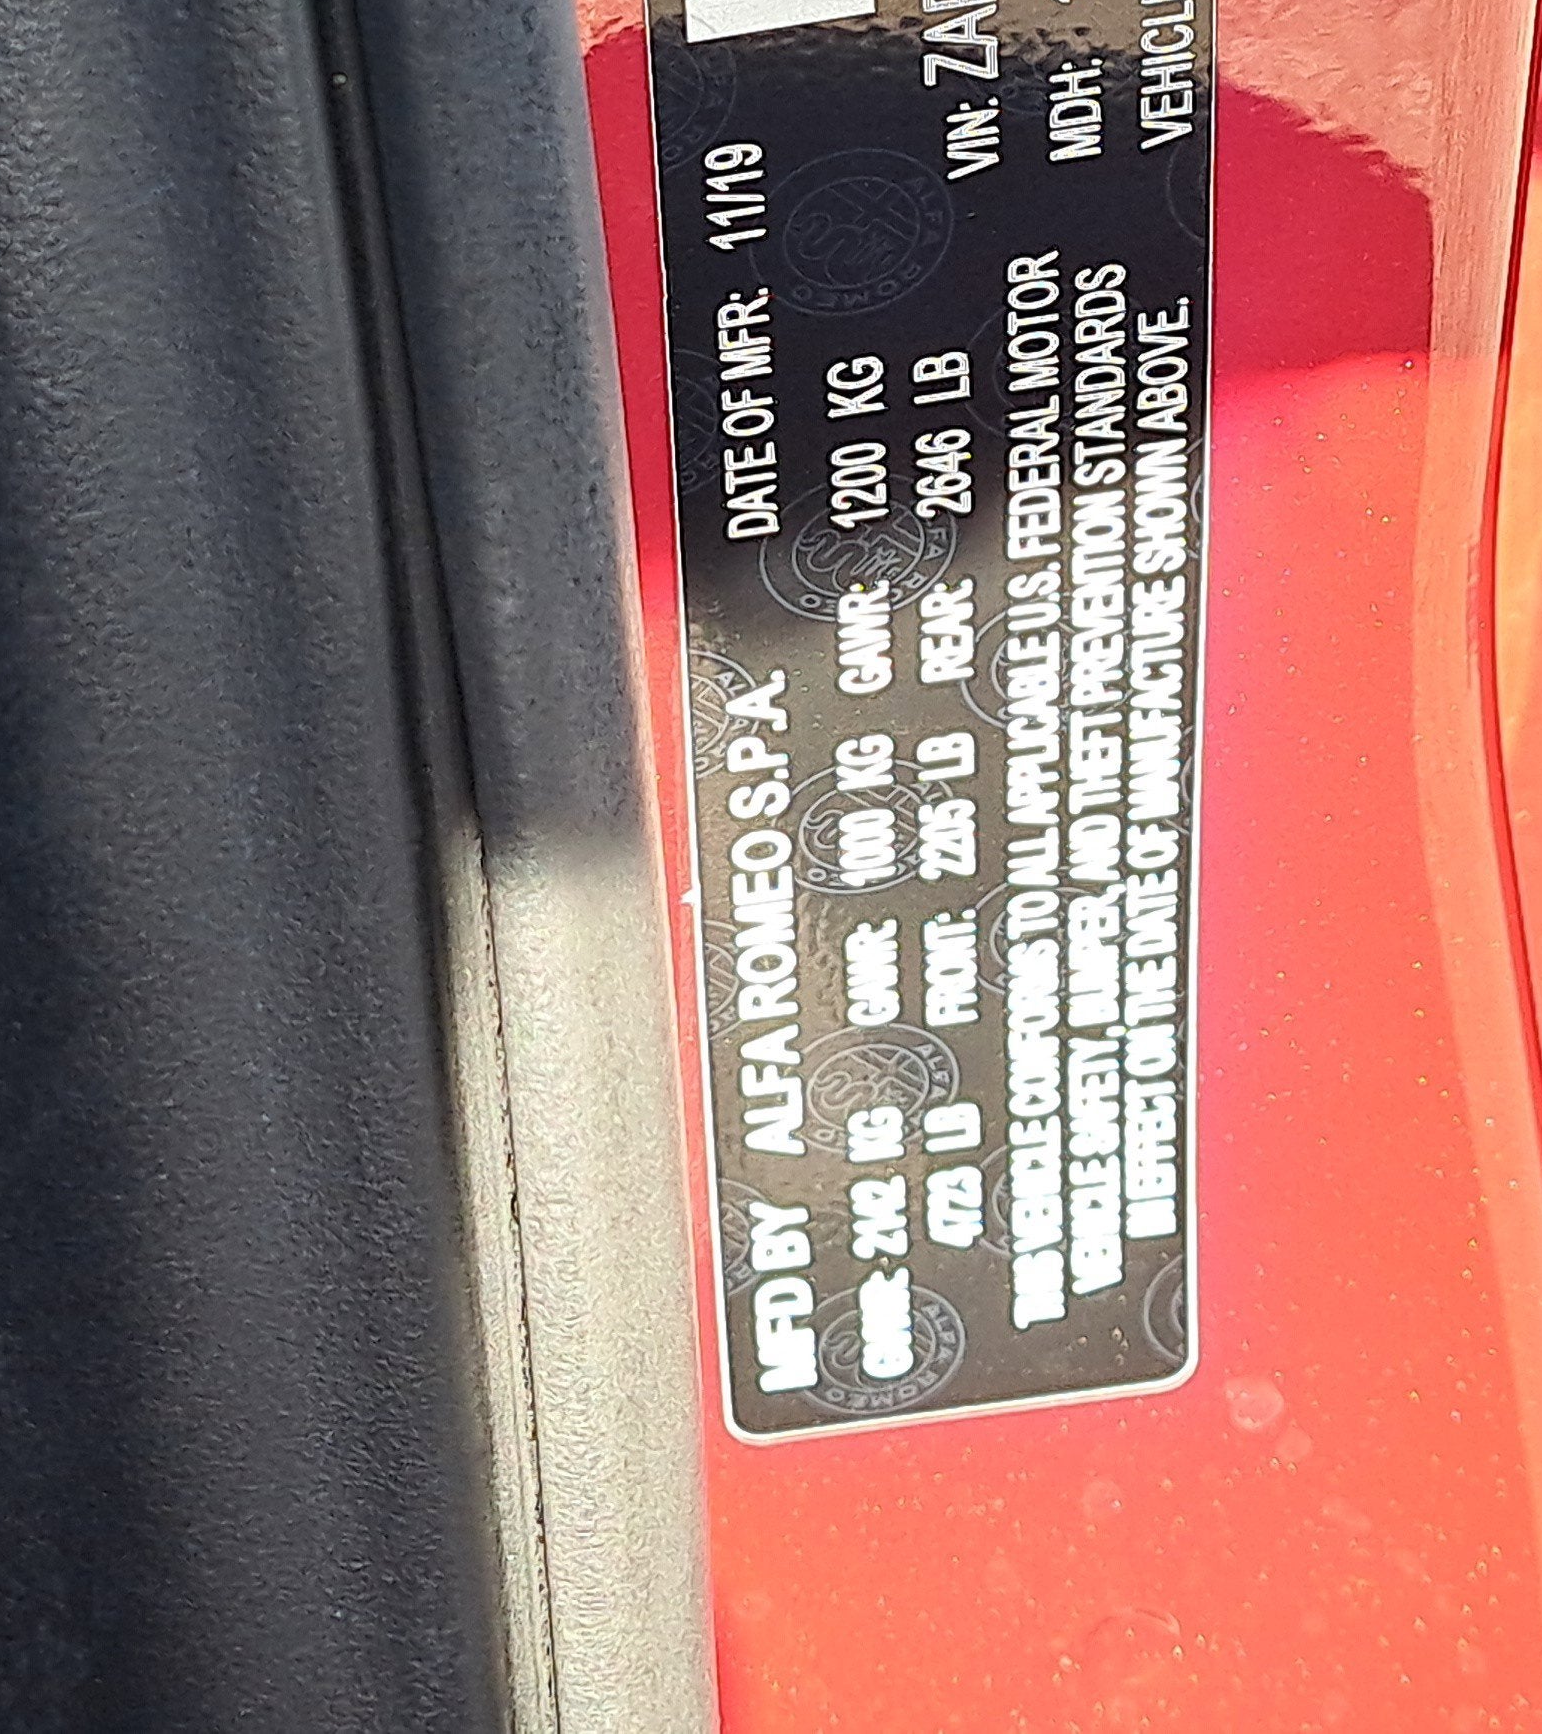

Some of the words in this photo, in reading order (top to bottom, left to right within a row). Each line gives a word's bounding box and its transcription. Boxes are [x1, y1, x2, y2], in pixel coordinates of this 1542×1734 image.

[947, 98, 1001, 179] VIN:
[1049, 58, 1103, 161] MDH:
[704, 143, 767, 250] 11/19
[717, 287, 772, 381] MFR:
[1008, 251, 1059, 391] MOTOR
[1138, 297, 1189, 430] ABOVE.
[721, 385, 774, 436] OF
[827, 356, 885, 417] KG
[914, 352, 971, 406] LB
[1075, 264, 1126, 484] STANDARDS
[723, 443, 780, 538] DATE
[829, 443, 888, 529] 1200
[916, 429, 973, 517] 2646
[1008, 395, 1059, 559] FEDERAL
[1135, 435, 1187, 574] SHOWN
[836, 580, 893, 694] GAWR:
[920, 579, 973, 684] REAR:
[1009, 563, 1060, 628] U.S.
[1071, 491, 1124, 707] PREVENTION
[1007, 636, 1060, 824] APPLICABLE
[1130, 575, 1185, 820] MANUFACTURE
[836, 734, 893, 789] KG
[916, 734, 974, 782] LB
[1070, 709, 1123, 813] THEFT
[839, 810, 895, 886] 1000
[919, 799, 976, 879] 2205
[1008, 827, 1060, 888] ALL
[1070, 815, 1123, 880] AND
[1130, 822, 1179, 868] OF
[730, 829, 799, 1017] ROMEO
[1010, 892, 1061, 936] TO
[1127, 871, 1178, 955] DATE
[845, 920, 899, 1027] GAWR:
[922, 909, 980, 1028] FRONT:
[1127, 957, 1177, 1028] THE
[1010, 938, 1062, 1116] CONFORMS
[1127, 1028, 1176, 1076] ON
[739, 1025, 805, 1156] ALFA
[848, 1106, 906, 1163] KG
[923, 1103, 981, 1151] LB
[1070, 1028, 1125, 1156] SAFETY,
[1010, 1118, 1063, 1249] VEHICLE
[1126, 1081, 1176, 1200] EFFECT
[748, 1201, 812, 1271] BY
[1070, 1159, 1123, 1295] VEHICLE
[756, 1275, 818, 1391] MFD
